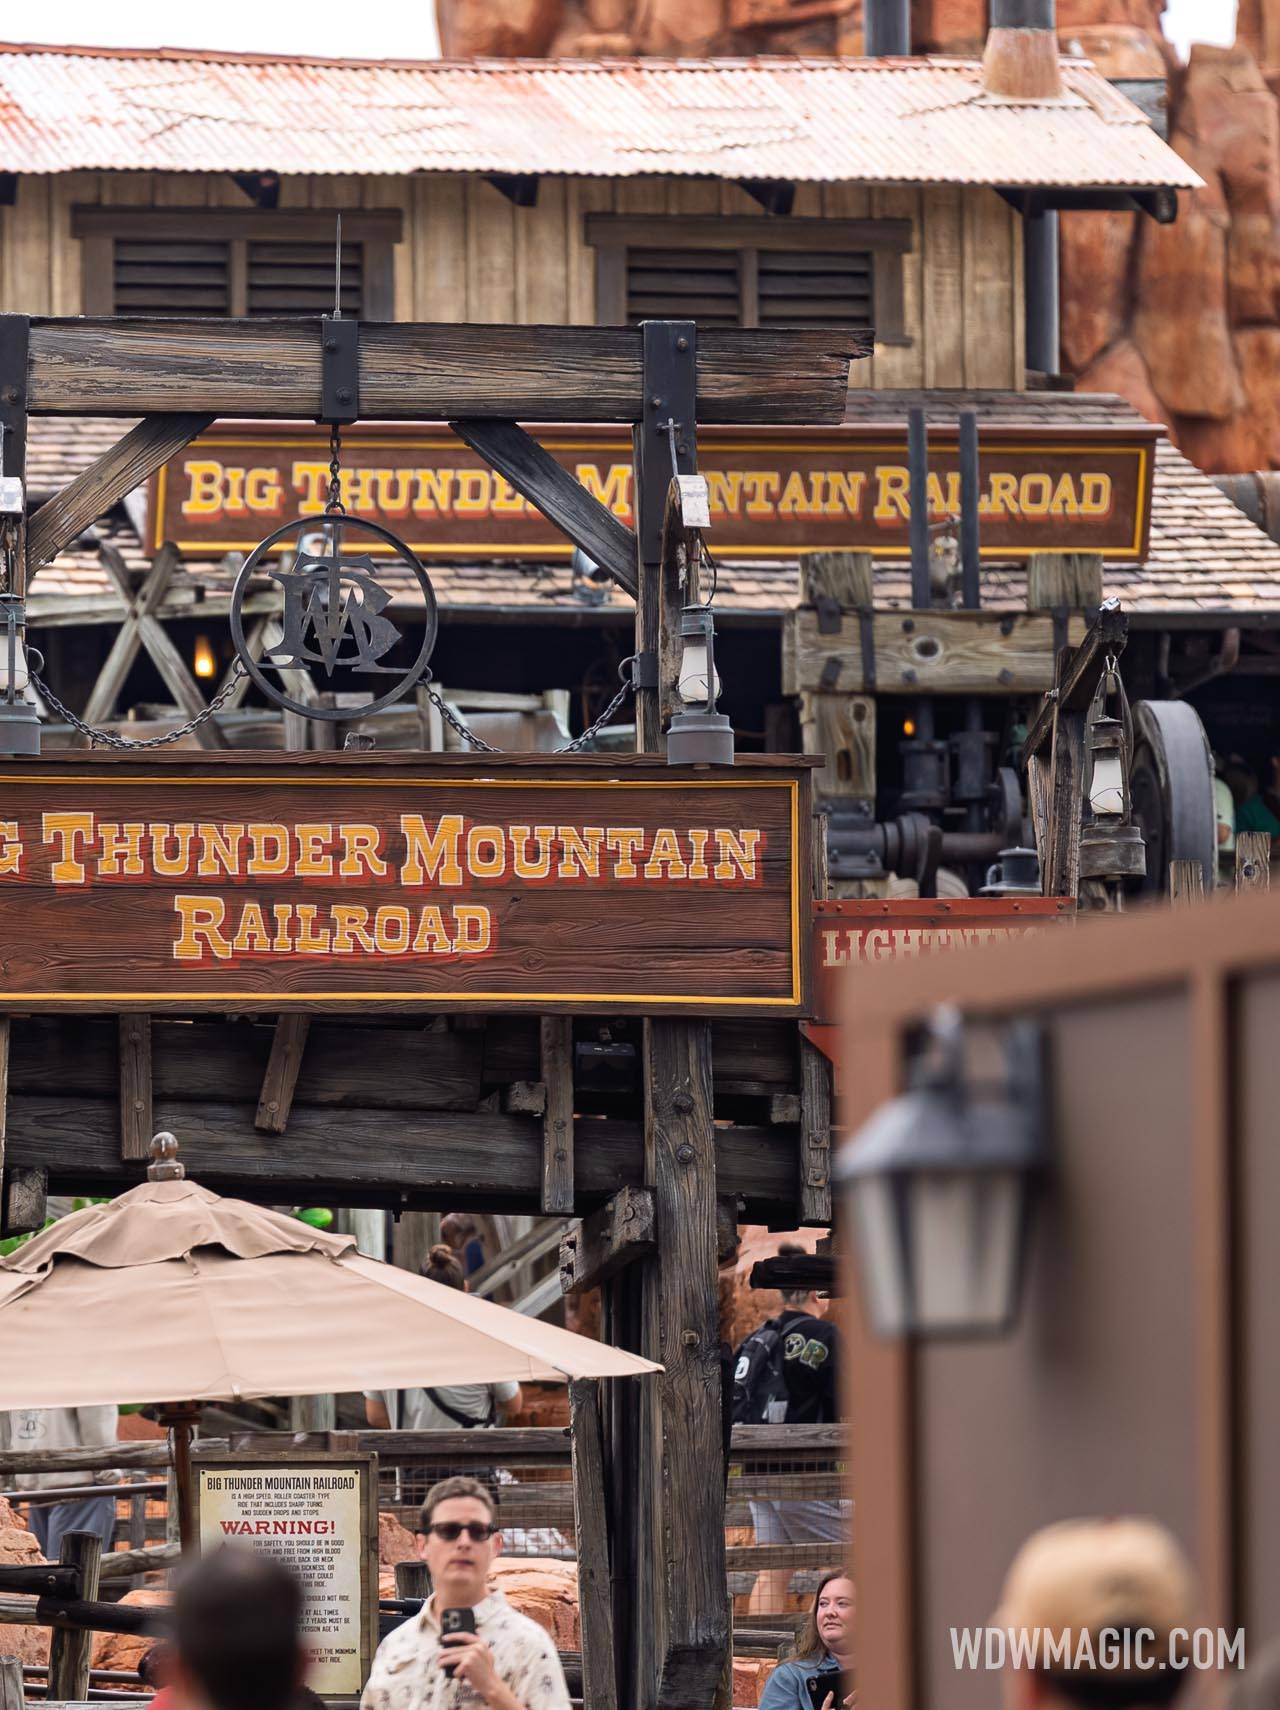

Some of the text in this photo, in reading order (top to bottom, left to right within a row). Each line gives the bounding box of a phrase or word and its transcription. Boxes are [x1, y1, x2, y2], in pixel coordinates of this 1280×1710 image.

[291, 461, 548, 516] THUNDE
[575, 464, 866, 515] MNTAIN
[41, 811, 388, 884] THUNDER
[400, 814, 761, 886] MOUNTAIN
[173, 895, 491, 960] RAILROAD
[207, 1477, 355, 1490] BIG THUNDER MOUNTAIN RAILROAD
[219, 1520, 336, 1535] WARNING!
